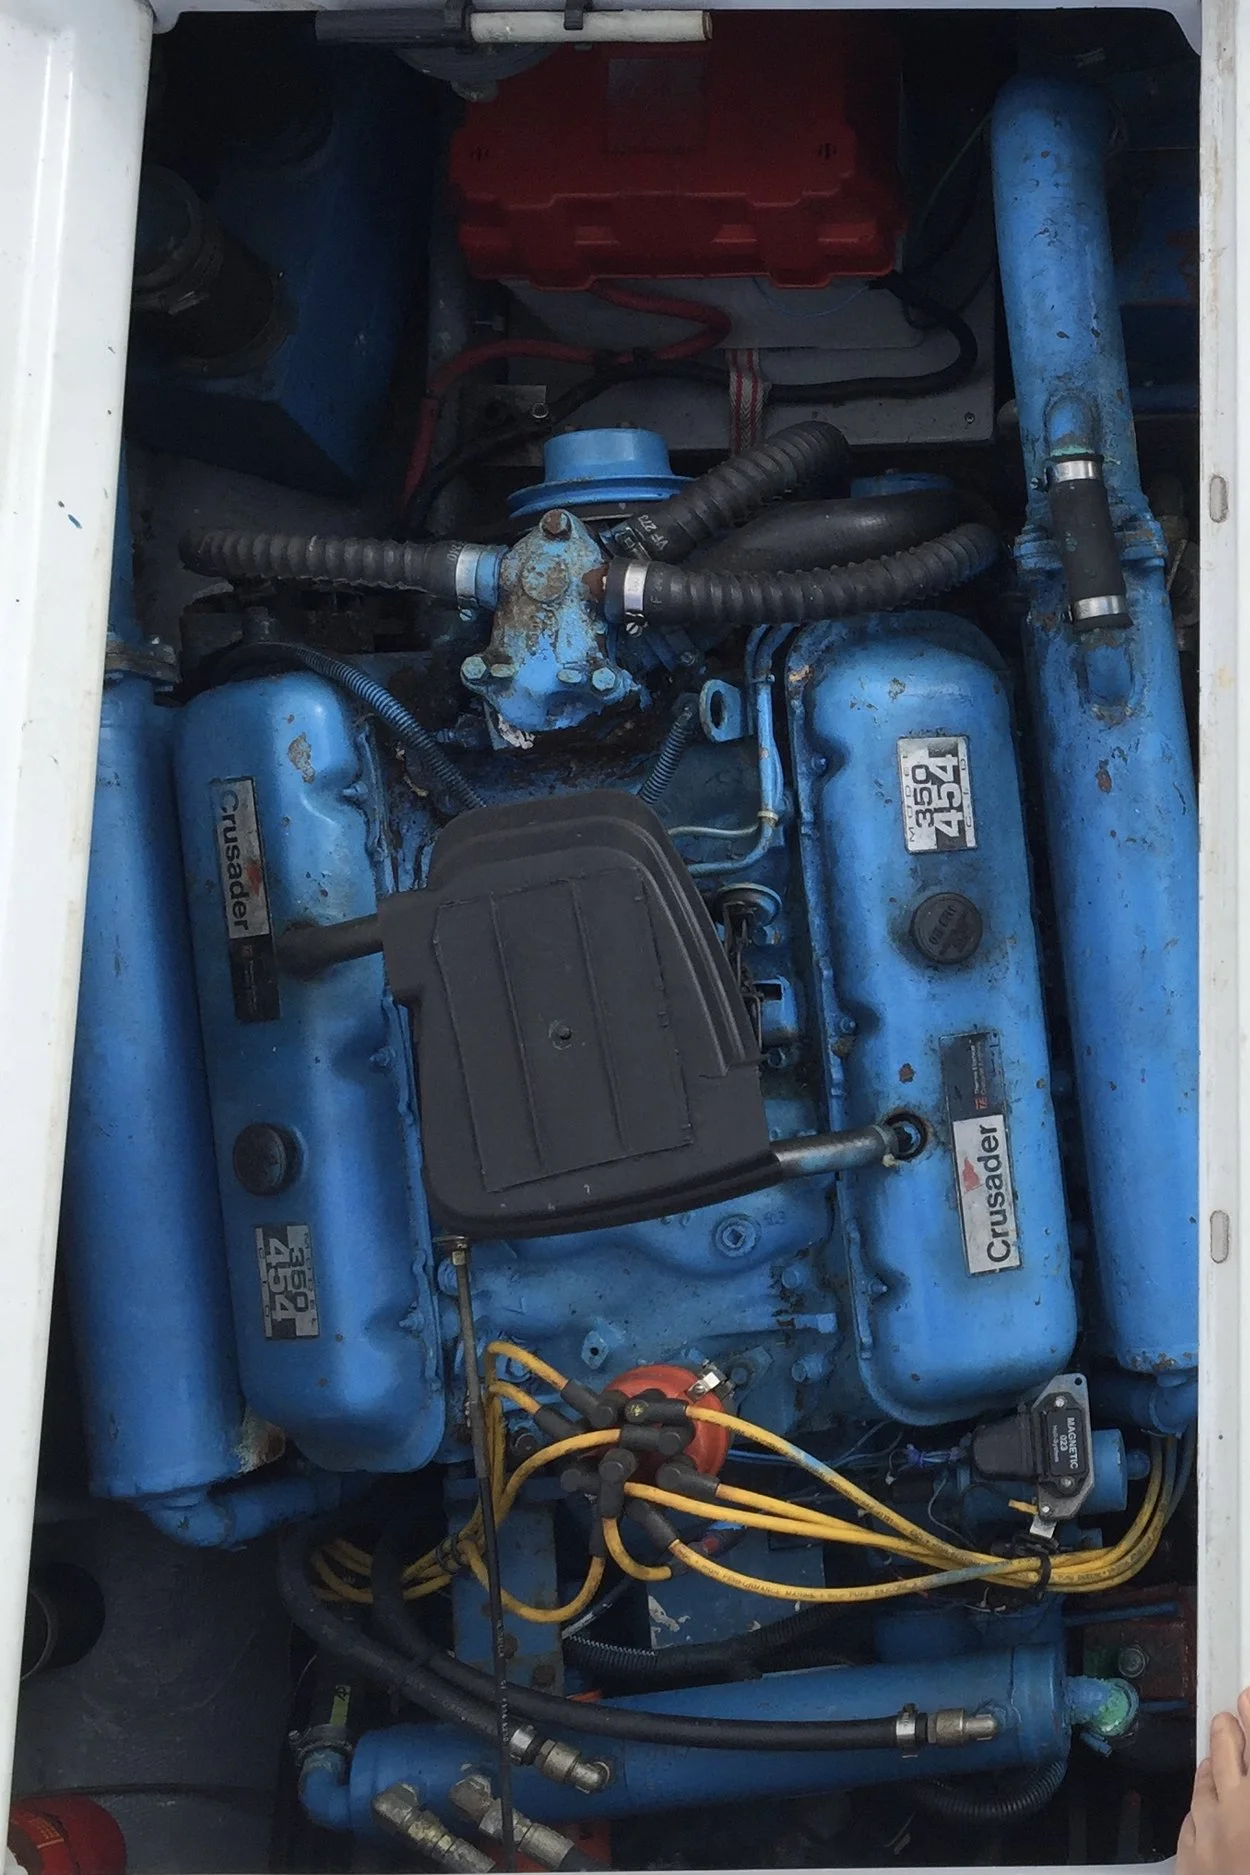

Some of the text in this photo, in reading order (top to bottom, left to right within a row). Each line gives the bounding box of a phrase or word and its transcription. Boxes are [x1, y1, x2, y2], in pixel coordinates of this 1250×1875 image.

[911, 764, 934, 828] 350
[928, 753, 963, 838] 454
[219, 789, 250, 930] Crusader
[977, 1124, 1011, 1263] Crusader
[265, 1237, 297, 1321] 454
[1066, 1417, 1079, 1470] MAGNETIC
